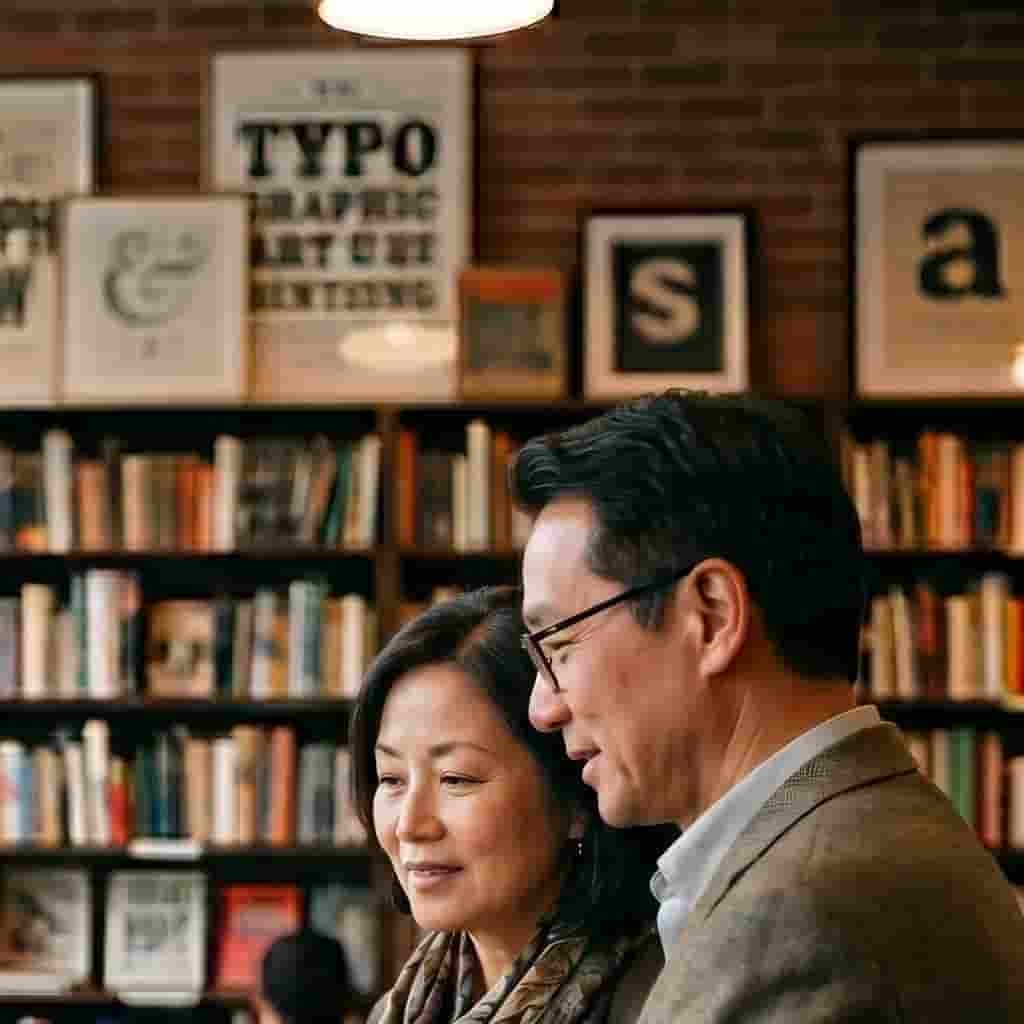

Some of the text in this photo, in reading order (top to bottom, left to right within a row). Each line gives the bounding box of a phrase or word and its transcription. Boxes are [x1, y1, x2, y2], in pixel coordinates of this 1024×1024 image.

[237, 121, 437, 177] TYPO
[102, 230, 210, 329] &
[917, 207, 1007, 301] a
